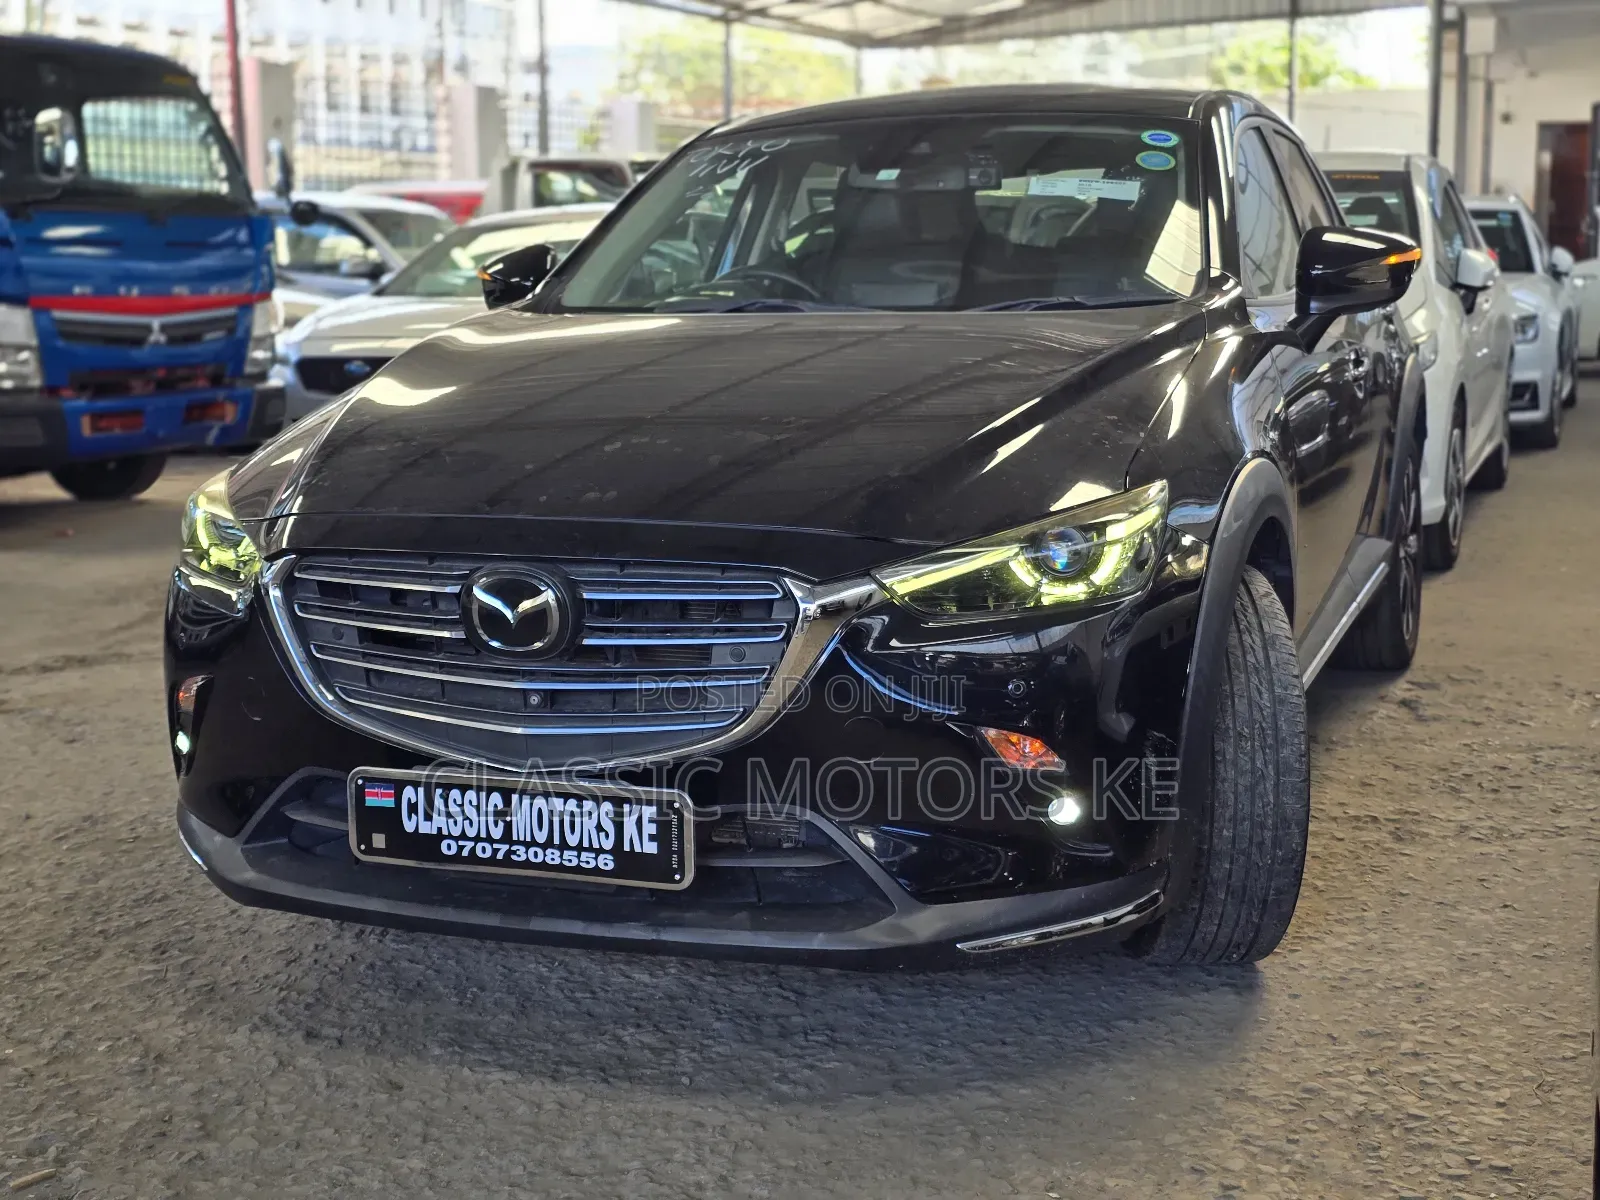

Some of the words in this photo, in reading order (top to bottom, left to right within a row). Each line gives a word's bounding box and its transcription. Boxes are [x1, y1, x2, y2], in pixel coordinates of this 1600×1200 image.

[401, 785, 504, 840] CLASSIC
[511, 793, 615, 851] MOTORS
[622, 803, 658, 855] KE
[440, 839, 615, 871] 0707308556
